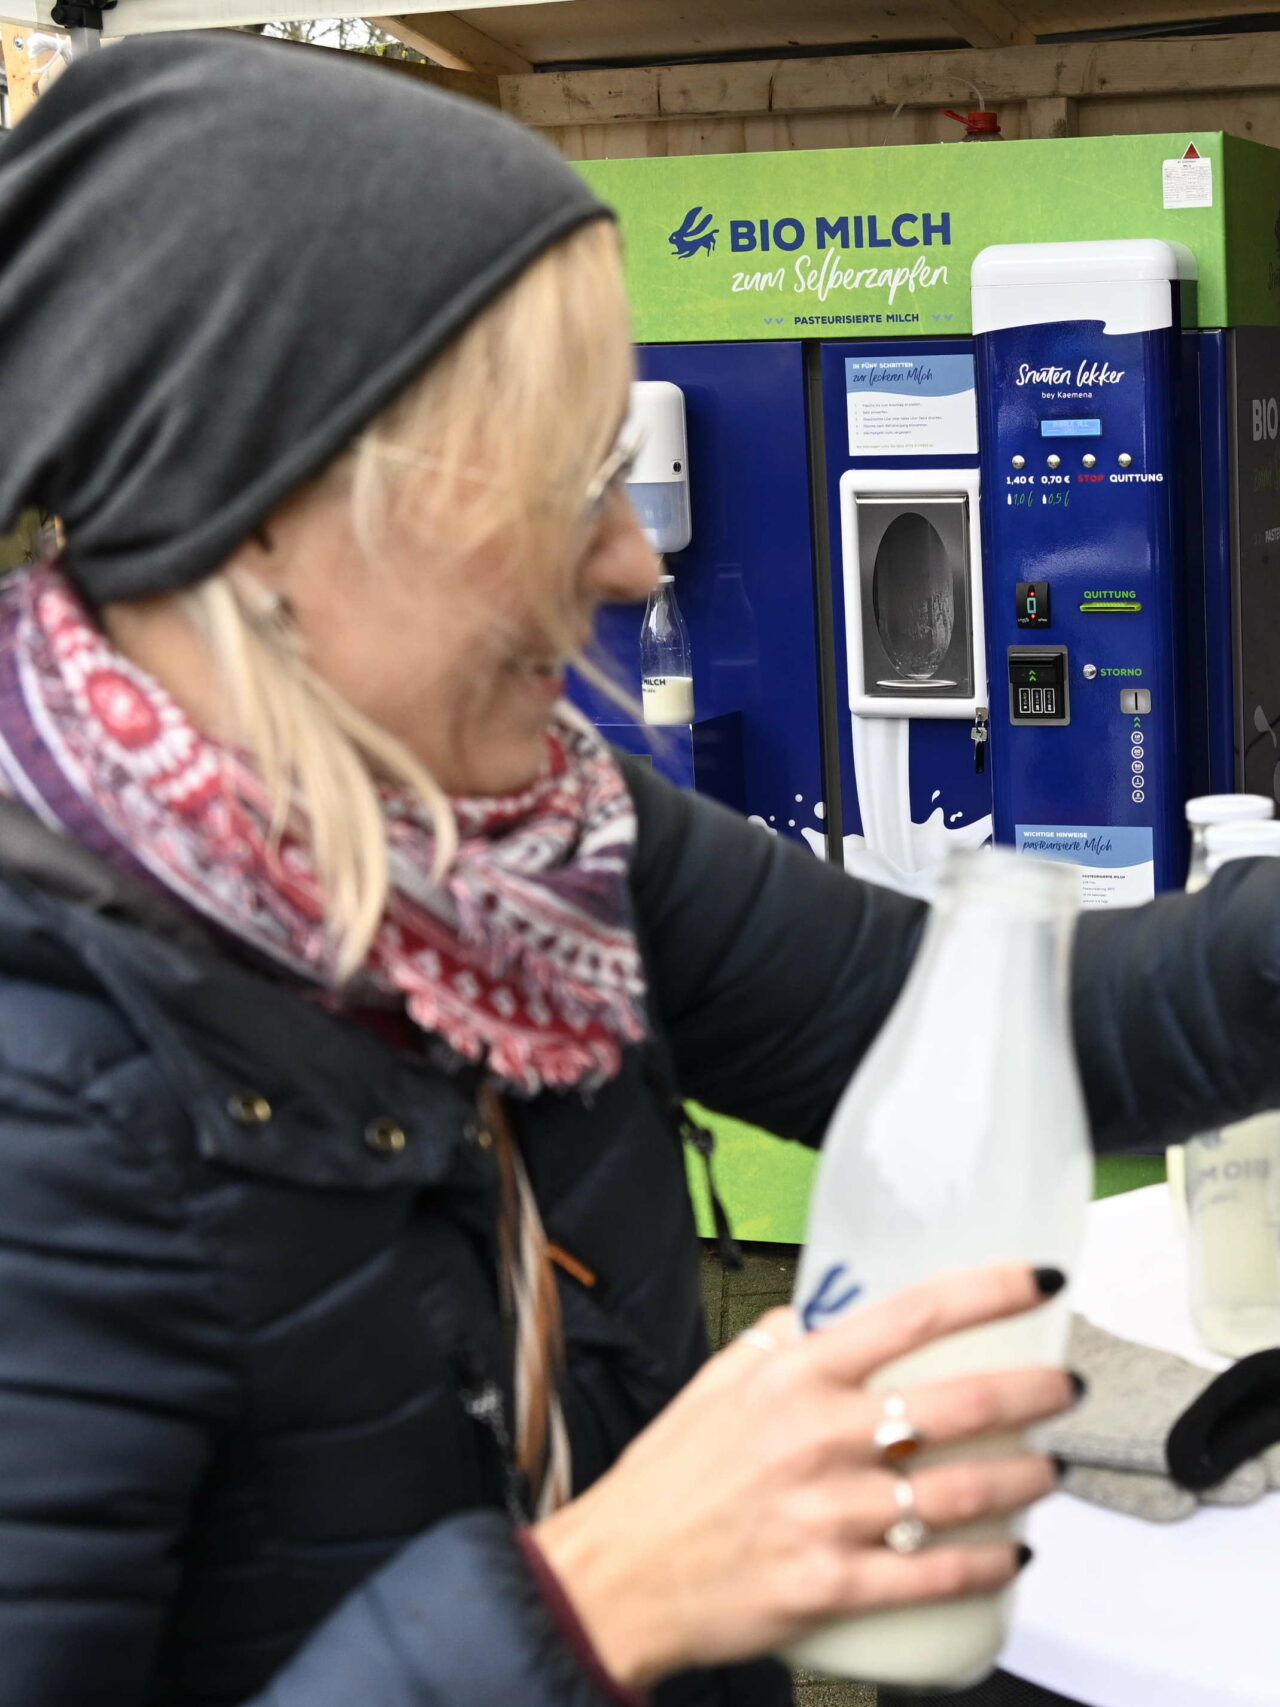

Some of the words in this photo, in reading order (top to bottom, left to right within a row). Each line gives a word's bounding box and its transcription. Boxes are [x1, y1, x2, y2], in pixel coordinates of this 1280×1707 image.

[730, 218, 805, 252] BIO
[816, 212, 951, 250] MILCH
[732, 268, 785, 292] zum
[794, 247, 949, 305] Selberzapfen
[794, 314, 882, 326] PASTEURISIERTE
[886, 313, 920, 323] MILCH
[906, 365, 933, 384] Milch
[1016, 364, 1072, 386] Snuten
[1077, 360, 1125, 387] lekker
[1252, 398, 1278, 441] BIO
[1006, 476, 1026, 485] 1,40
[1028, 476, 1034, 484] €
[1041, 476, 1062, 484] 0,70
[1064, 475, 1070, 484] €
[1078, 474, 1104, 483] STOP
[1110, 474, 1164, 482] QUITTUNG
[1084, 590, 1136, 600] QUITTUNG
[1100, 668, 1142, 676] STORNO
[1022, 839, 1080, 853] pasteurisierte
[1084, 836, 1112, 855] Milch
